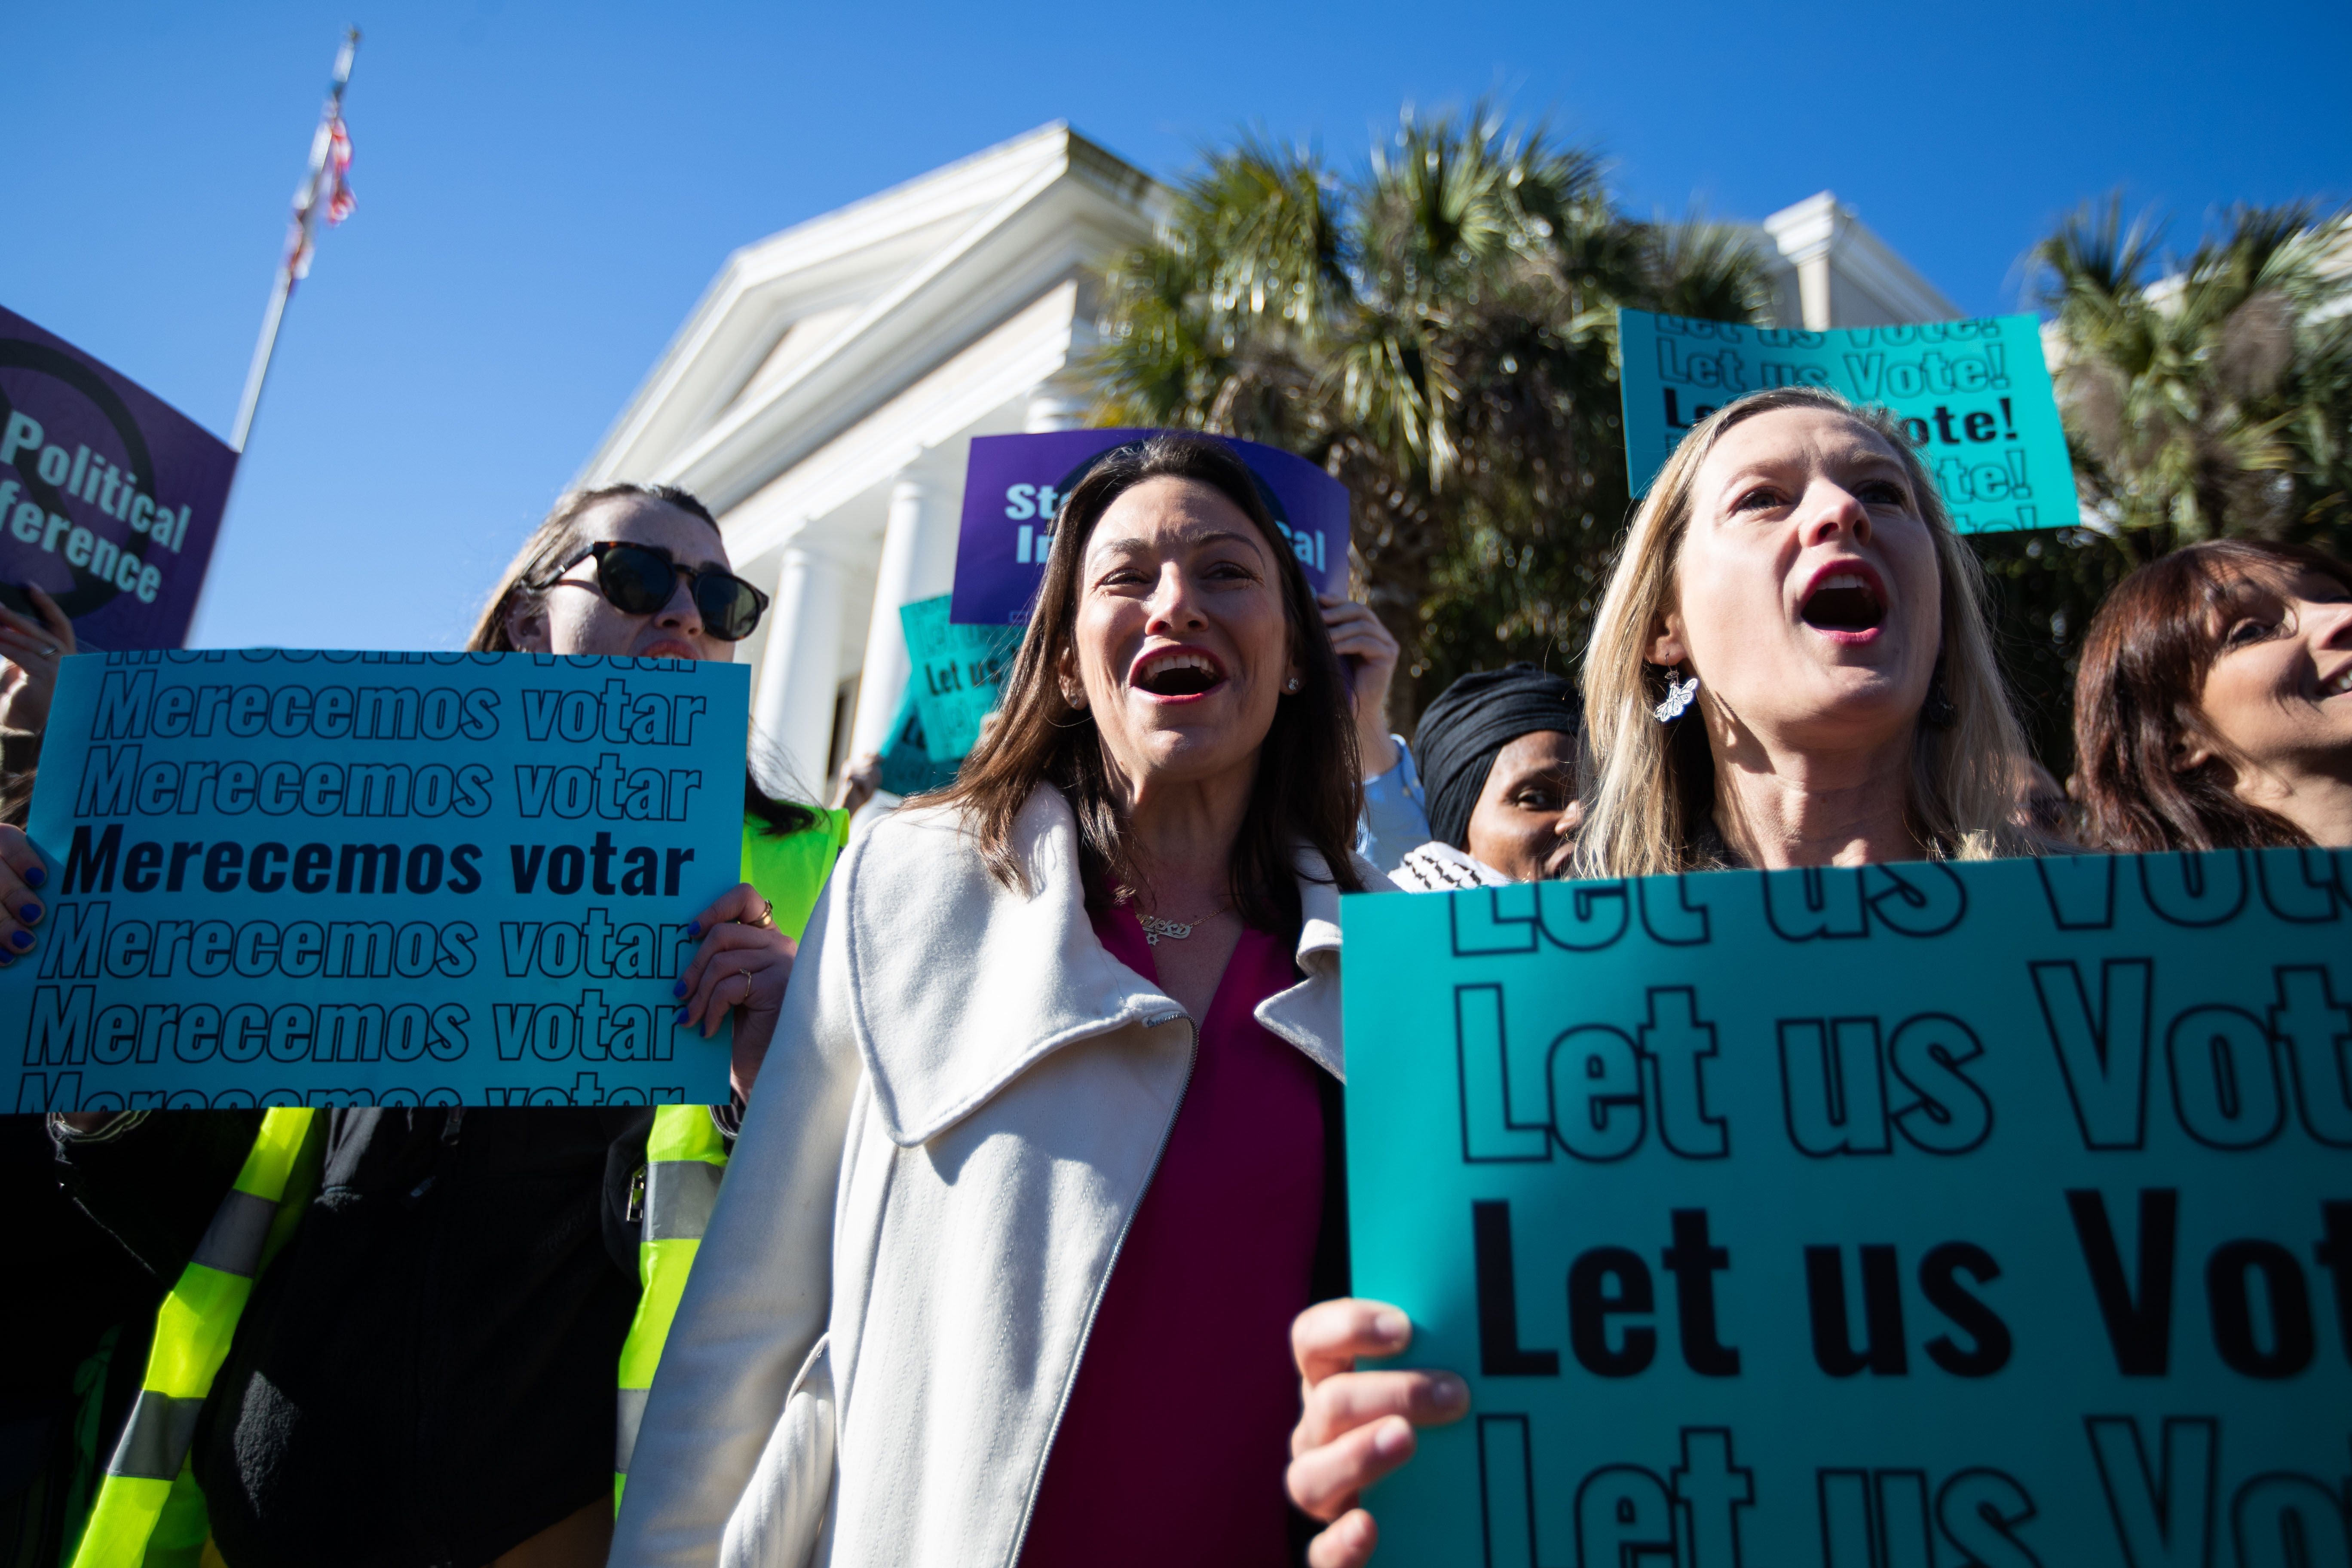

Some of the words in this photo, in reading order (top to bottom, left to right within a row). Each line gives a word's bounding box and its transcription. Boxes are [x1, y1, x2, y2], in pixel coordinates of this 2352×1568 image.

[1656, 334, 1745, 393] Let
[1842, 342, 2011, 400] Vote!
[1877, 397, 2018, 446] ote!
[0, 410, 192, 554] Political
[1004, 483, 1071, 520] St
[91, 669, 501, 741] Merecemos
[522, 678, 707, 746] votar
[74, 744, 493, 818] Merecemos
[514, 753, 702, 822] votar
[61, 824, 483, 895] Merecemos
[510, 831, 695, 897] votar
[37, 900, 478, 980] Merecemos
[499, 907, 692, 980] votar
[23, 984, 470, 1066] Merecemos
[493, 989, 687, 1062] votar
[1453, 981, 1731, 1163] Let
[1776, 1011, 1994, 1160] us
[2027, 957, 2352, 1152] Vot
[1471, 1198, 1741, 1379] Let
[1804, 1240, 2013, 1379] us
[2082, 1413, 2352, 1568] Vo
